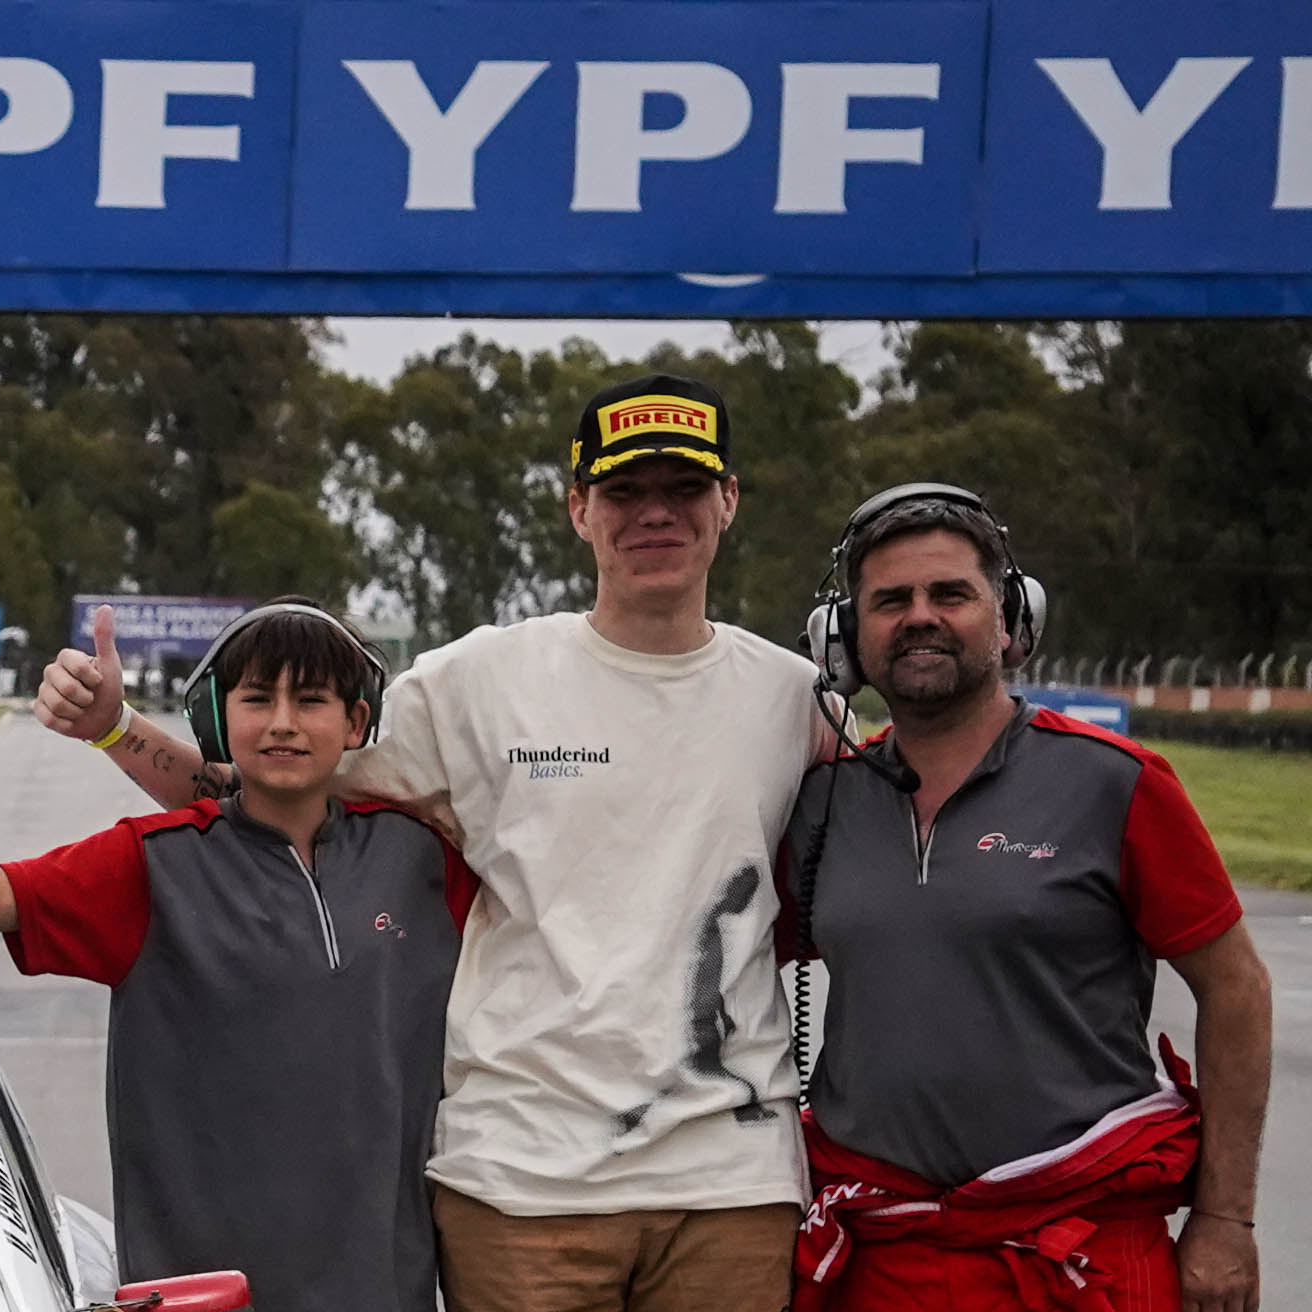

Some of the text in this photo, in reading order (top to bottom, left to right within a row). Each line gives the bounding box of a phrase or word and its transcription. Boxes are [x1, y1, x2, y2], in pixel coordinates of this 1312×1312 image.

[341, 59, 940, 214] YPF
[610, 404, 707, 434] PIRELLI
[507, 746, 610, 764] Thunderind
[529, 762, 583, 779] Basics.
